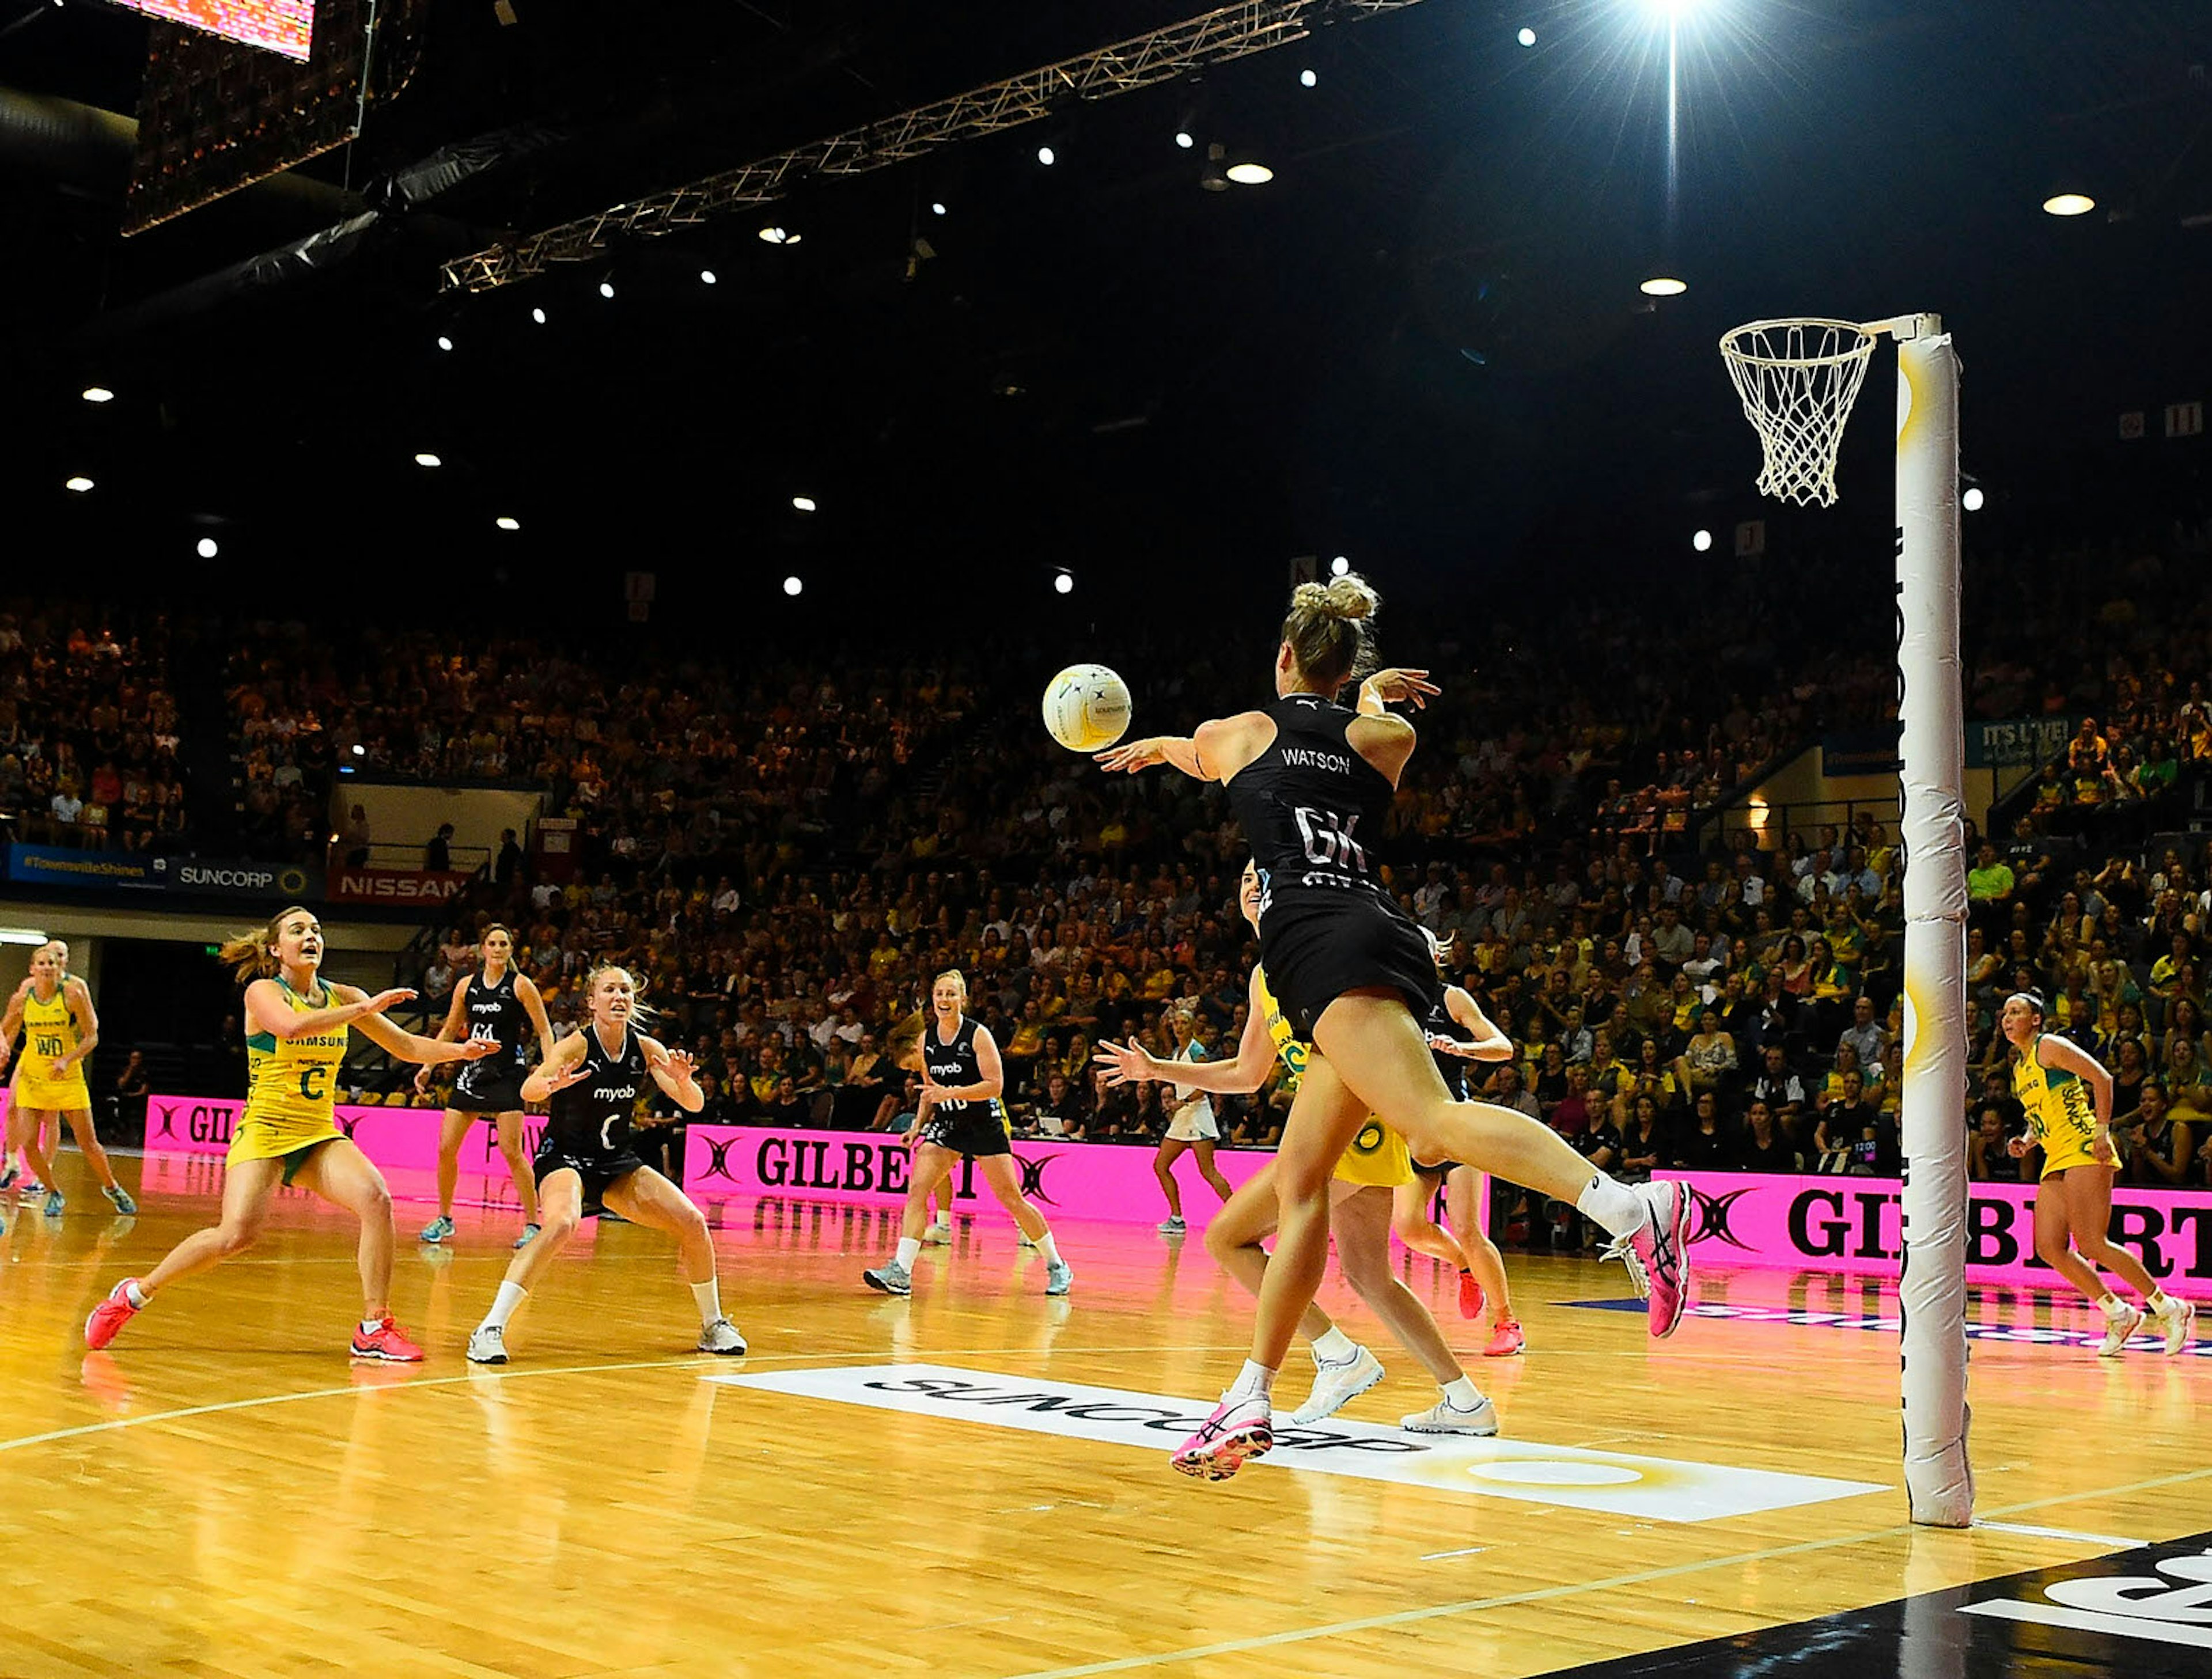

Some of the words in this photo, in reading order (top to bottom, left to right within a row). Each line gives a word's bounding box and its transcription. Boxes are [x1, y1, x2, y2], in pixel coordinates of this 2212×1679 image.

[2020, 720, 2070, 744] LVE!
[1281, 748, 1350, 775] WATSON
[1295, 806, 1368, 874] GK
[180, 866, 273, 889] SUNCORP
[340, 875, 465, 899] NISSAN
[472, 1002, 502, 1014] myob
[36, 1037, 63, 1057] WD
[286, 1036, 348, 1047] AMSUN
[930, 1062, 962, 1077] myob
[300, 1067, 327, 1100] C
[593, 1084, 636, 1102] myob
[757, 1137, 977, 1200] GILBET
[1788, 1189, 2212, 1278] GIBRT
